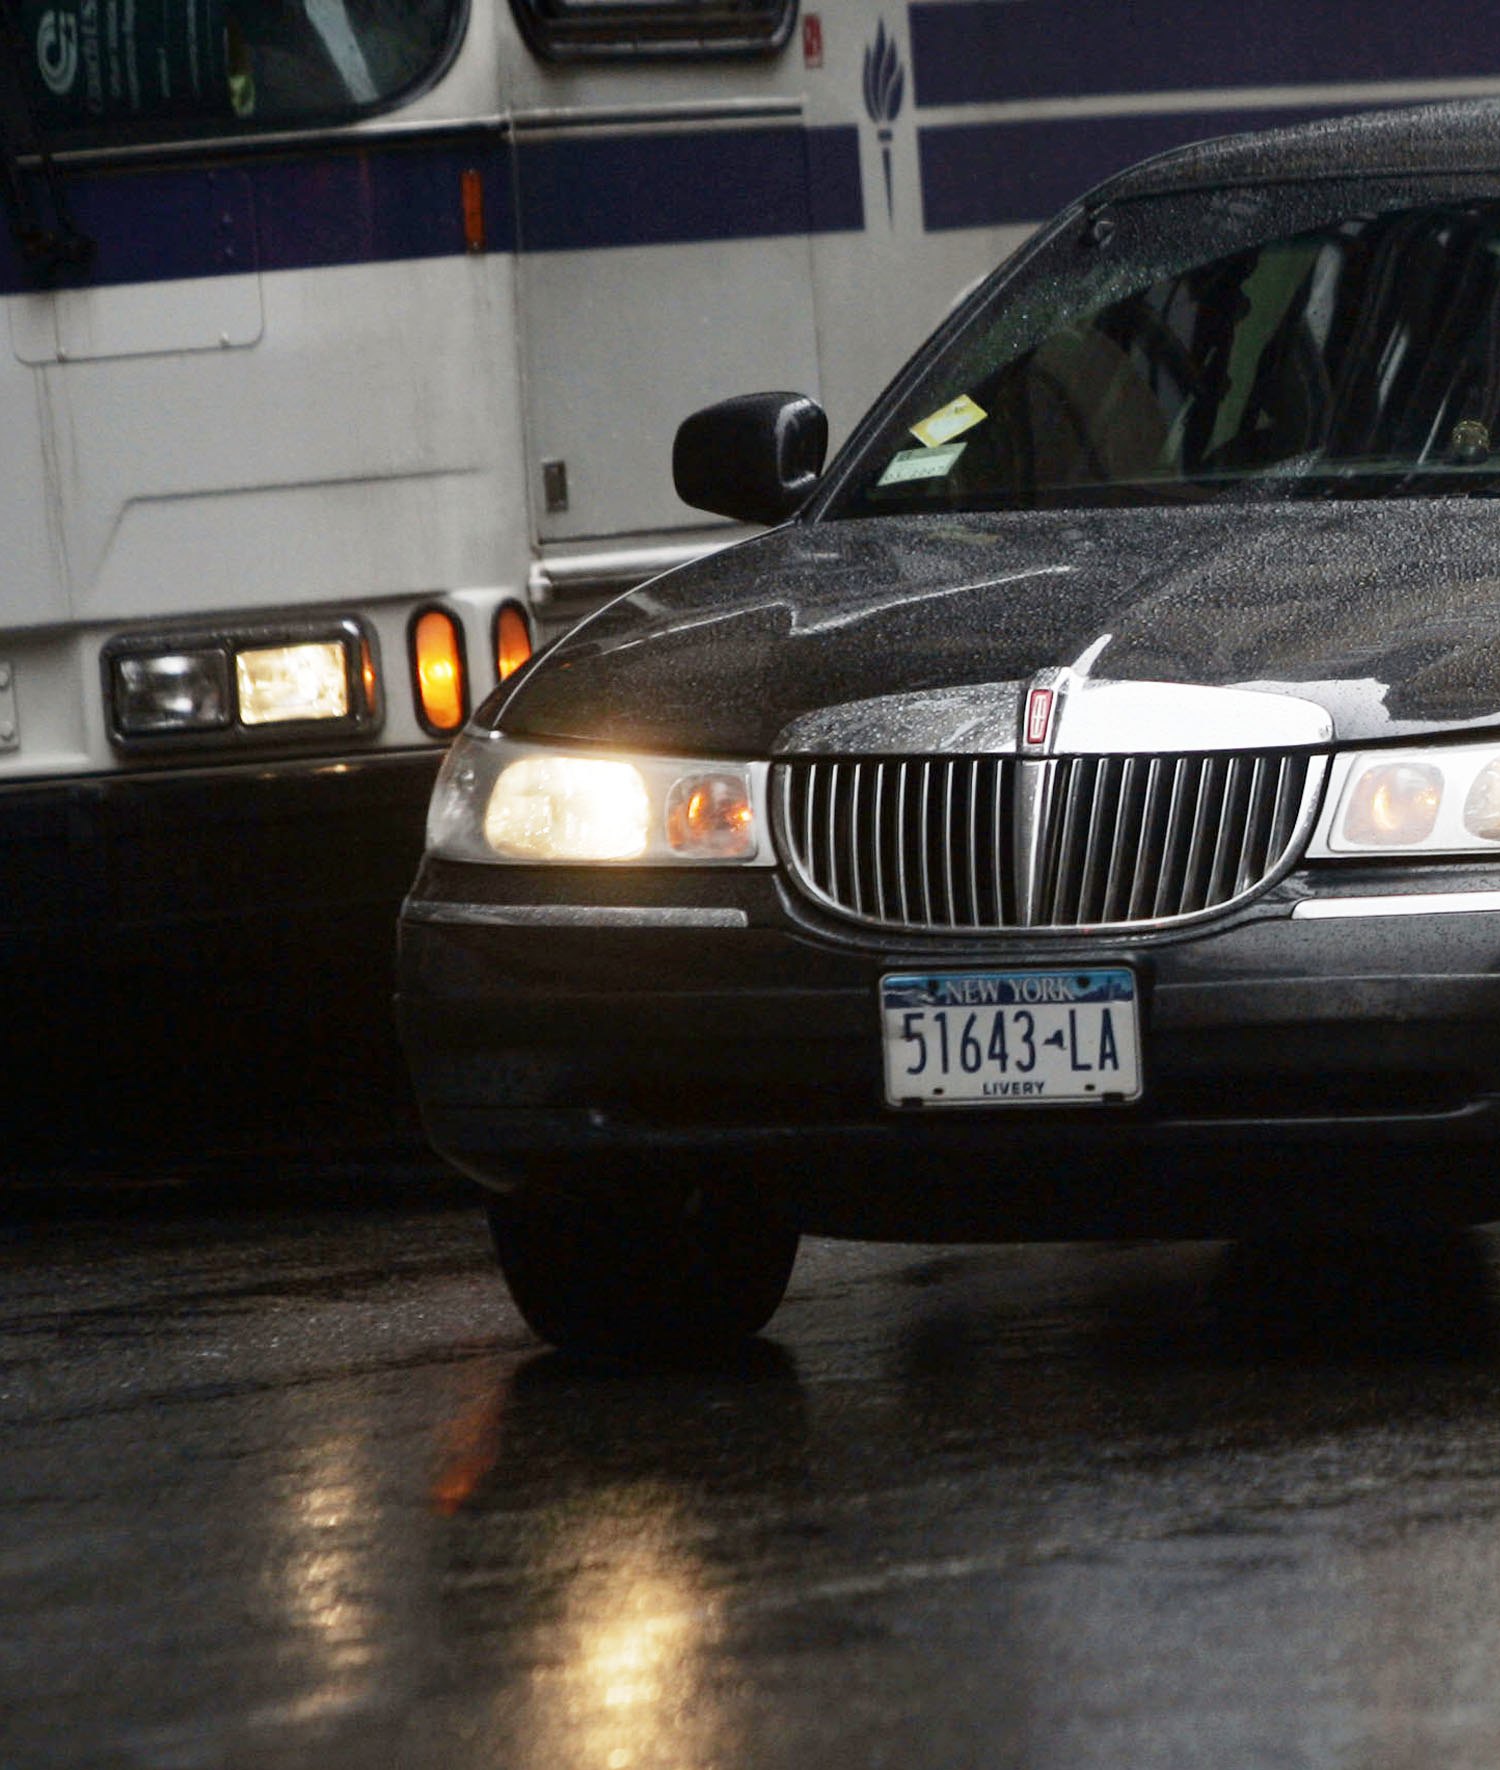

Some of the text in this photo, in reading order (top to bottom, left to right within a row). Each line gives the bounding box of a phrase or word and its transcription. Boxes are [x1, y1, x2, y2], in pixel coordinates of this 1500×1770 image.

[946, 976, 1075, 1004] NEW YORK
[982, 1081, 1046, 1096] LIVERY
